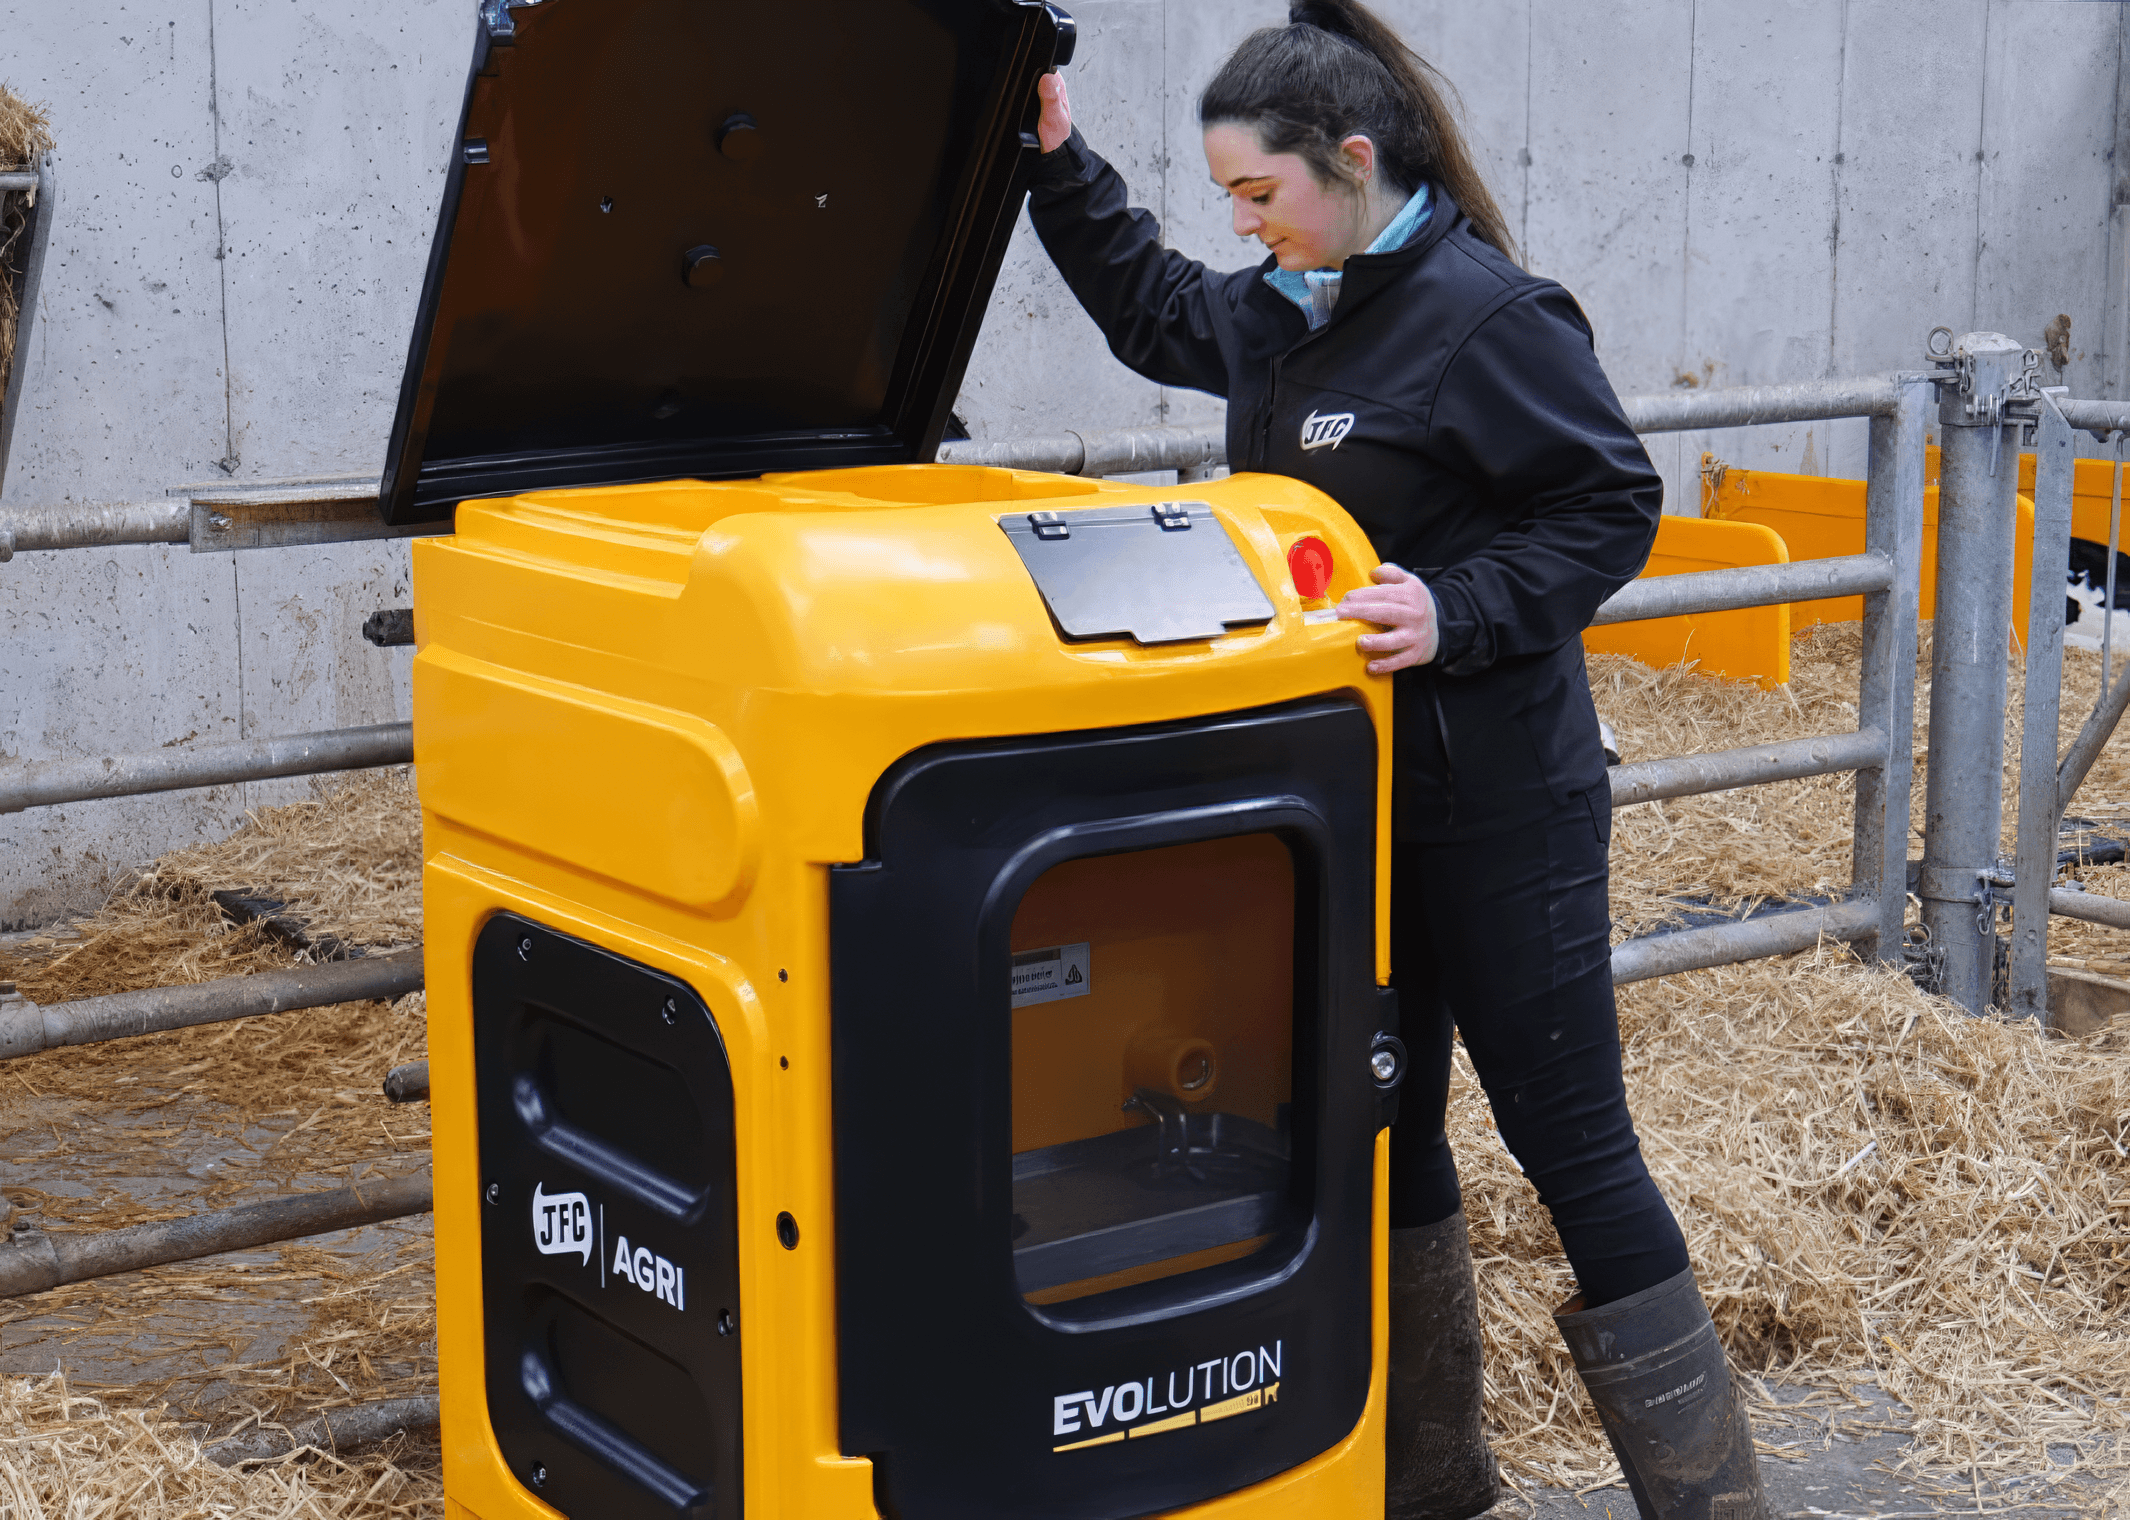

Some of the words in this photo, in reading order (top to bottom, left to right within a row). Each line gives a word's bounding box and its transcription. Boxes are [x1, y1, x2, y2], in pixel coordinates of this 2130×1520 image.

[1303, 417, 1351, 445] JFC
[540, 1200, 586, 1246] JFC
[612, 1235, 685, 1312] AGRI
[1053, 1339, 1282, 1436] EVOLUTION
